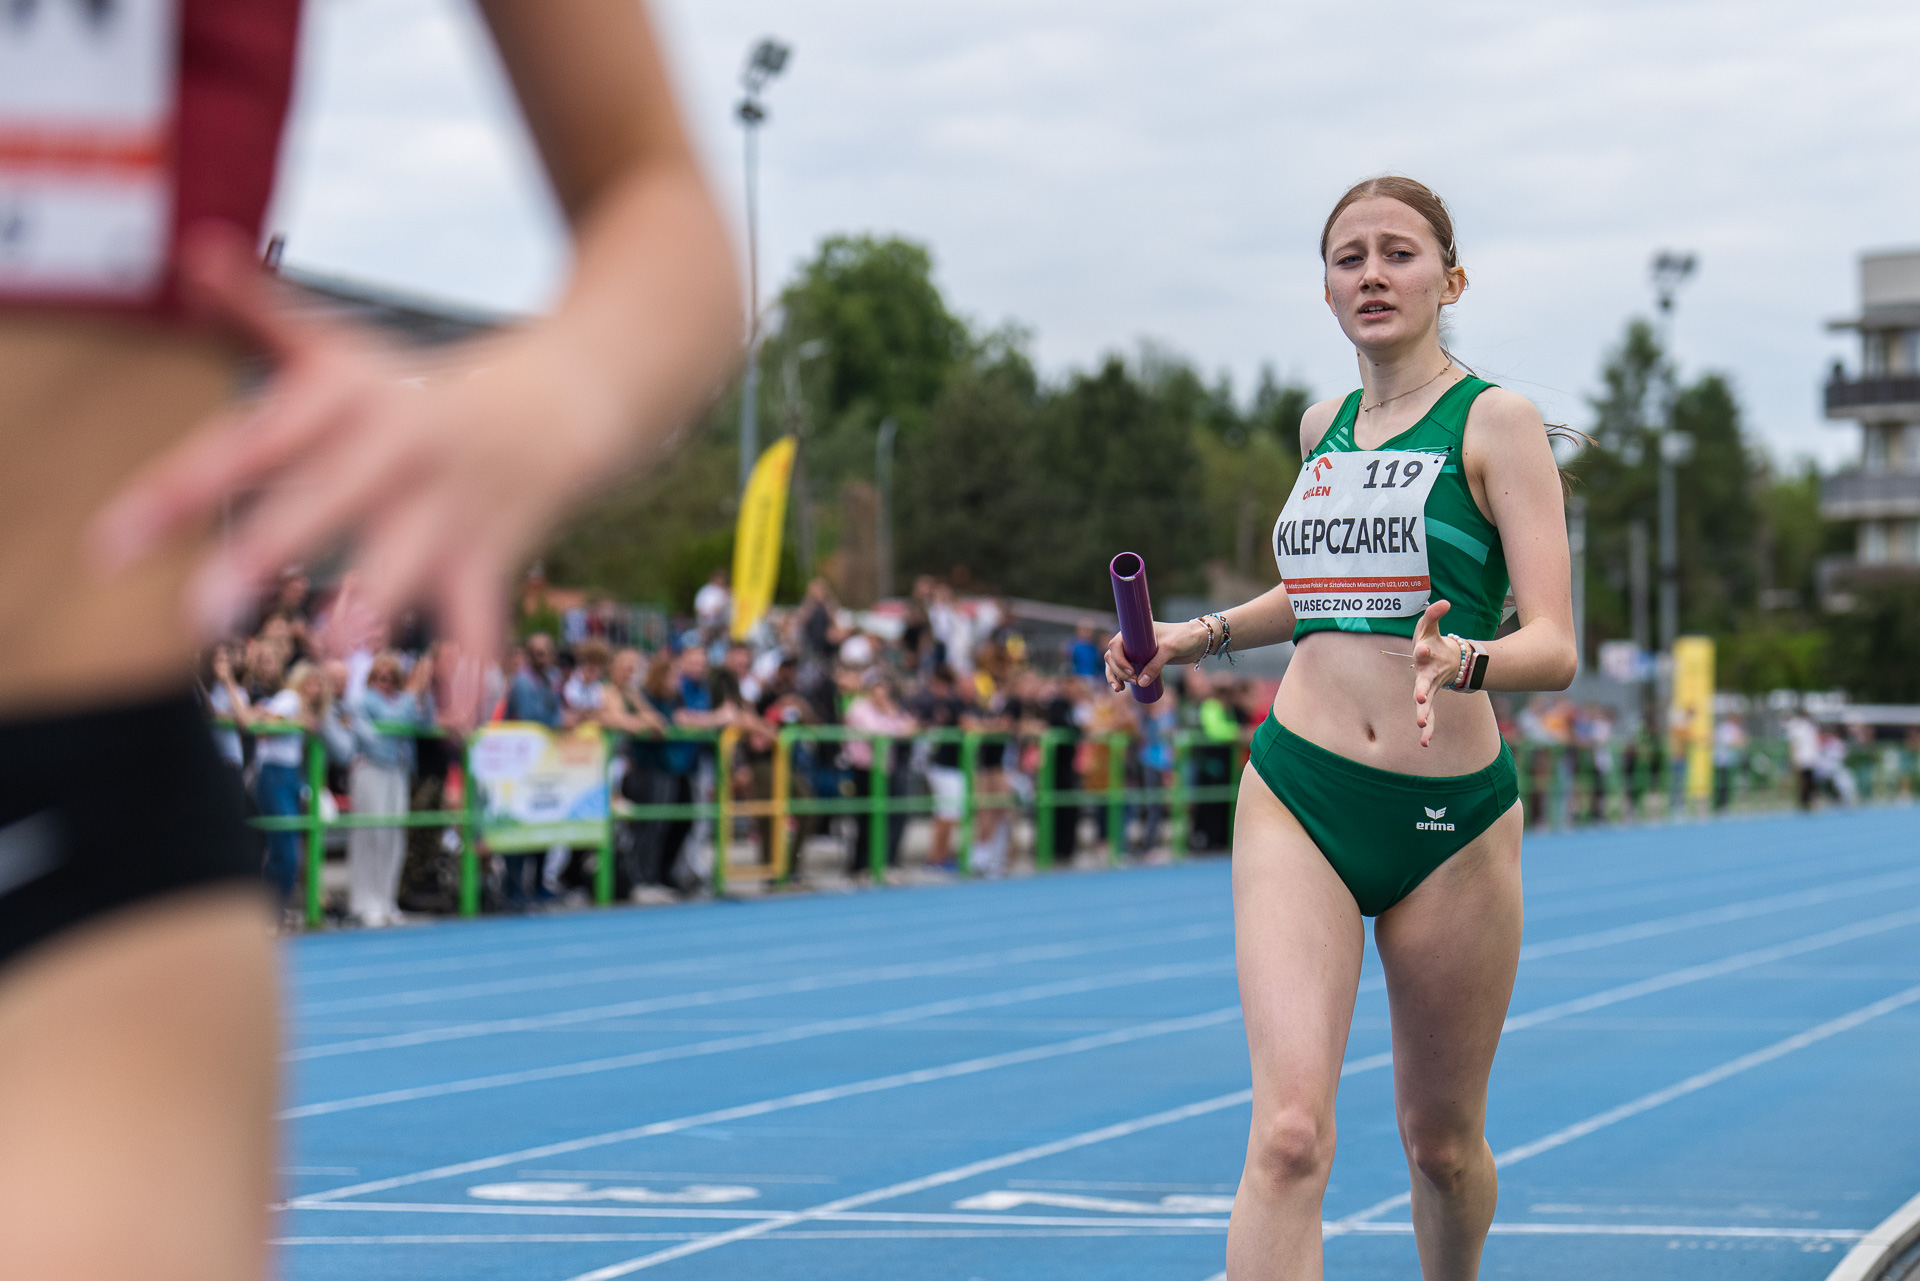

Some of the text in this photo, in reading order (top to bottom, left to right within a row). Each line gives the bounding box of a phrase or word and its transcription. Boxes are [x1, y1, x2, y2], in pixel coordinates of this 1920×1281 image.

[1362, 459, 1424, 489] 119
[1277, 516, 1420, 556] KLEPCZAREK
[1293, 598, 1402, 612] PIASECZNO 2026
[1416, 820, 1455, 831] erima
